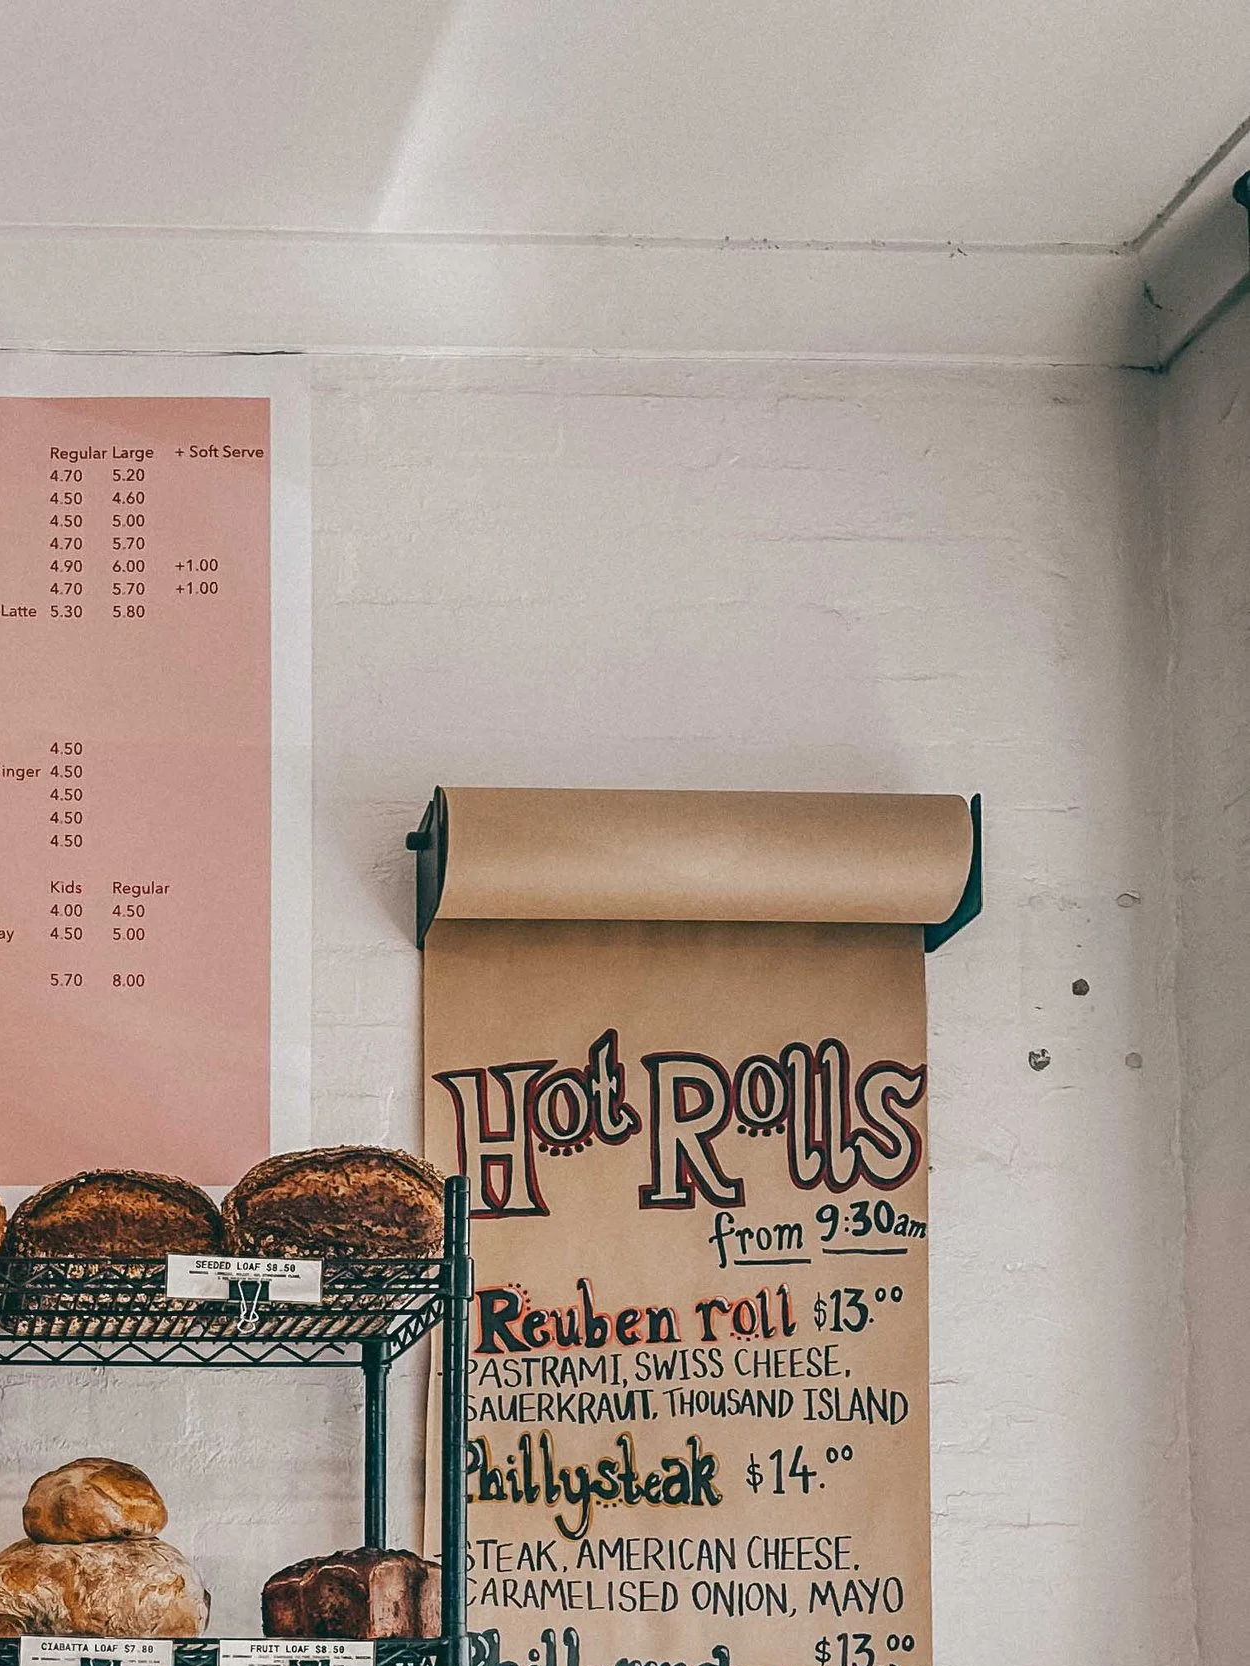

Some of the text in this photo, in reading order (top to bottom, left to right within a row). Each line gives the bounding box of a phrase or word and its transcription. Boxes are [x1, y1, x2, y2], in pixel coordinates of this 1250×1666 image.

[50, 445, 108, 464] Regular
[112, 445, 155, 463] Large
[189, 444, 220, 459] Soft
[222, 444, 265, 459] Serve
[49, 469, 83, 483] 4.70
[112, 468, 145, 482] 5.20
[49, 491, 83, 505] 4.50
[111, 491, 145, 505] 4.60
[49, 514, 83, 528] 4.50
[112, 513, 145, 528] 5.00
[49, 536, 83, 551] 4.70
[112, 536, 146, 551] 5.70
[49, 559, 83, 573] 4.90
[112, 559, 146, 573] 6.00
[174, 558, 219, 572] +1.00
[49, 582, 83, 596] 4.70
[111, 582, 146, 596] 5.70
[175, 581, 219, 595] +1.00
[1, 603, 37, 618] Latte
[50, 604, 83, 619] 5.30
[112, 604, 146, 619] 5.80
[49, 741, 83, 756] 4.50
[49, 764, 83, 779] 4.50
[49, 787, 83, 802] 4.50
[49, 811, 83, 825] 4.50
[49, 834, 83, 848] 4.50
[50, 879, 171, 899] Kids Regular
[49, 903, 83, 918] 4.00
[111, 904, 146, 918] 4.50
[49, 926, 83, 941] 4.50
[112, 927, 146, 941] 5.00
[50, 973, 146, 988] 5.70 8.00
[432, 1028, 927, 1218] Hot Rolls
[709, 1199, 927, 1268] from 9:30am
[195, 1260, 297, 1273] SEEDED LOAF $8.50
[473, 1276, 682, 1355] Reuben
[694, 1283, 798, 1343] roll
[635, 1347, 725, 1383] SWISS
[733, 1344, 852, 1379] CHEESE,
[662, 1387, 794, 1421] THOUSAND
[802, 1386, 910, 1426] ISLAND
[576, 1535, 737, 1574] AMERICAN
[691, 1579, 798, 1620] ONION,
[808, 1576, 905, 1617] MAYO
[40, 1642, 154, 1654] CIABATTA LOAF $7.80
[250, 1644, 345, 1655] FRUIT LOAF $8.50
